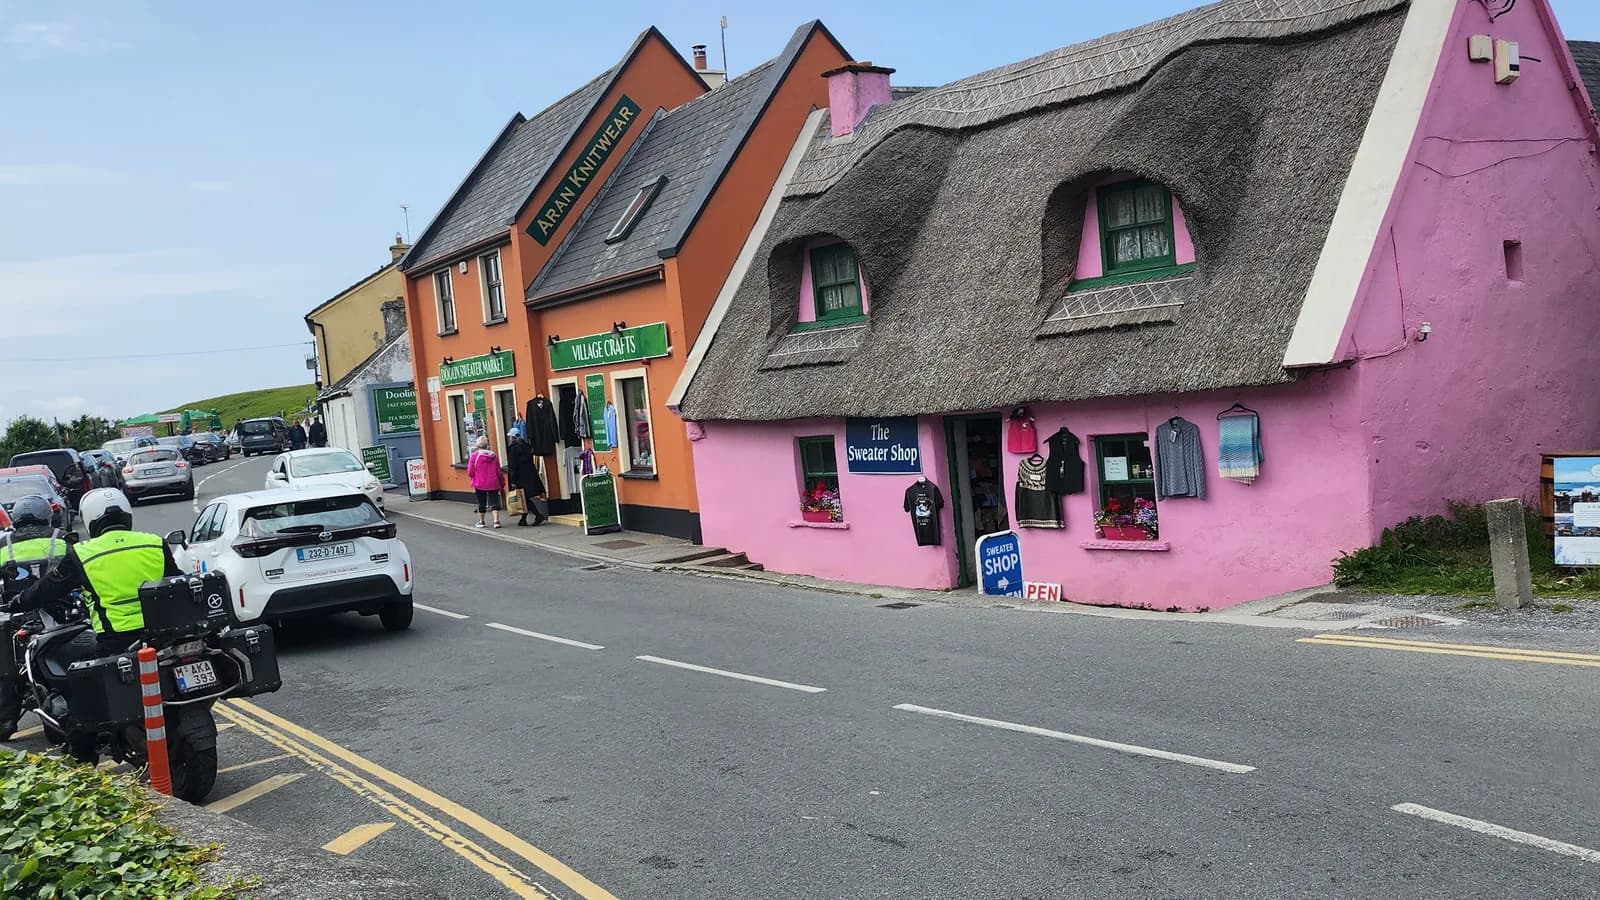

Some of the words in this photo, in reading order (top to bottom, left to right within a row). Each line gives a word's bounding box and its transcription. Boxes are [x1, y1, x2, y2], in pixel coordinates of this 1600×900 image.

[536, 186, 576, 237] ARAN
[568, 105, 635, 188] KNITWEAR
[571, 341, 603, 361] VILLAGE
[604, 335, 636, 357] CRAFTS
[385, 389, 416, 399] Doolin
[871, 423, 890, 441] The
[848, 445, 888, 461] Sweater
[890, 443, 917, 466] Shop
[308, 545, 349, 559] 232-D-7497
[986, 543, 1014, 556] SWEATER
[985, 553, 1018, 575] SHOP
[1027, 584, 1059, 601] PEN
[191, 661, 212, 674] AKA
[193, 671, 215, 685] 393
